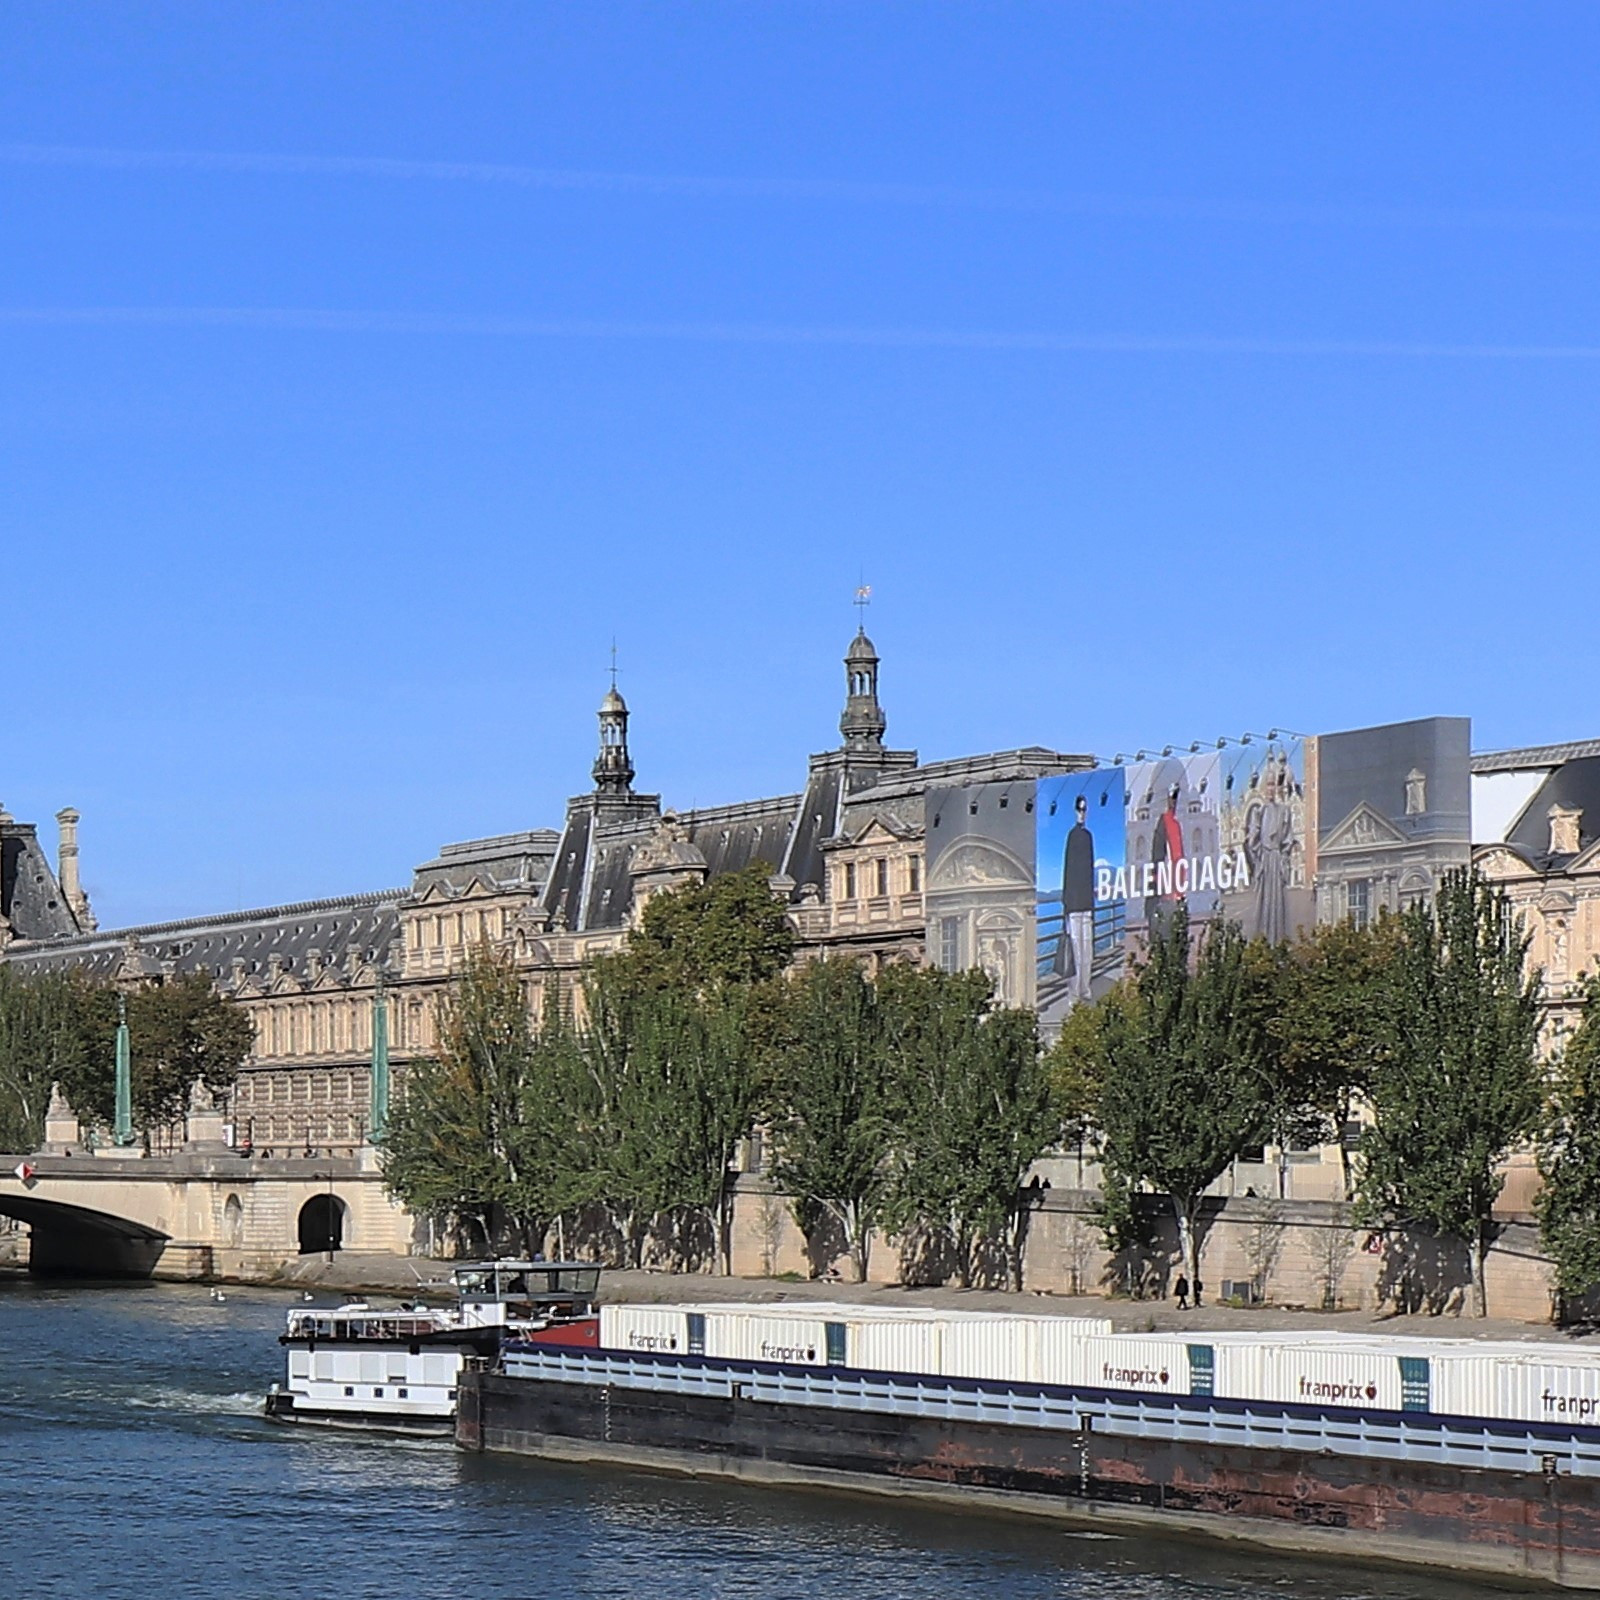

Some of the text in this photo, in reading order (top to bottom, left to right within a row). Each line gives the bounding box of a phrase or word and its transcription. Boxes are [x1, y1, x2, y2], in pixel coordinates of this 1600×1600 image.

[1097, 852, 1249, 901] BALENCIAGA
[629, 1330, 668, 1351] franprix
[761, 1341, 806, 1363] franprix
[1103, 1362, 1157, 1387] franprix
[1299, 1376, 1363, 1401] franprix
